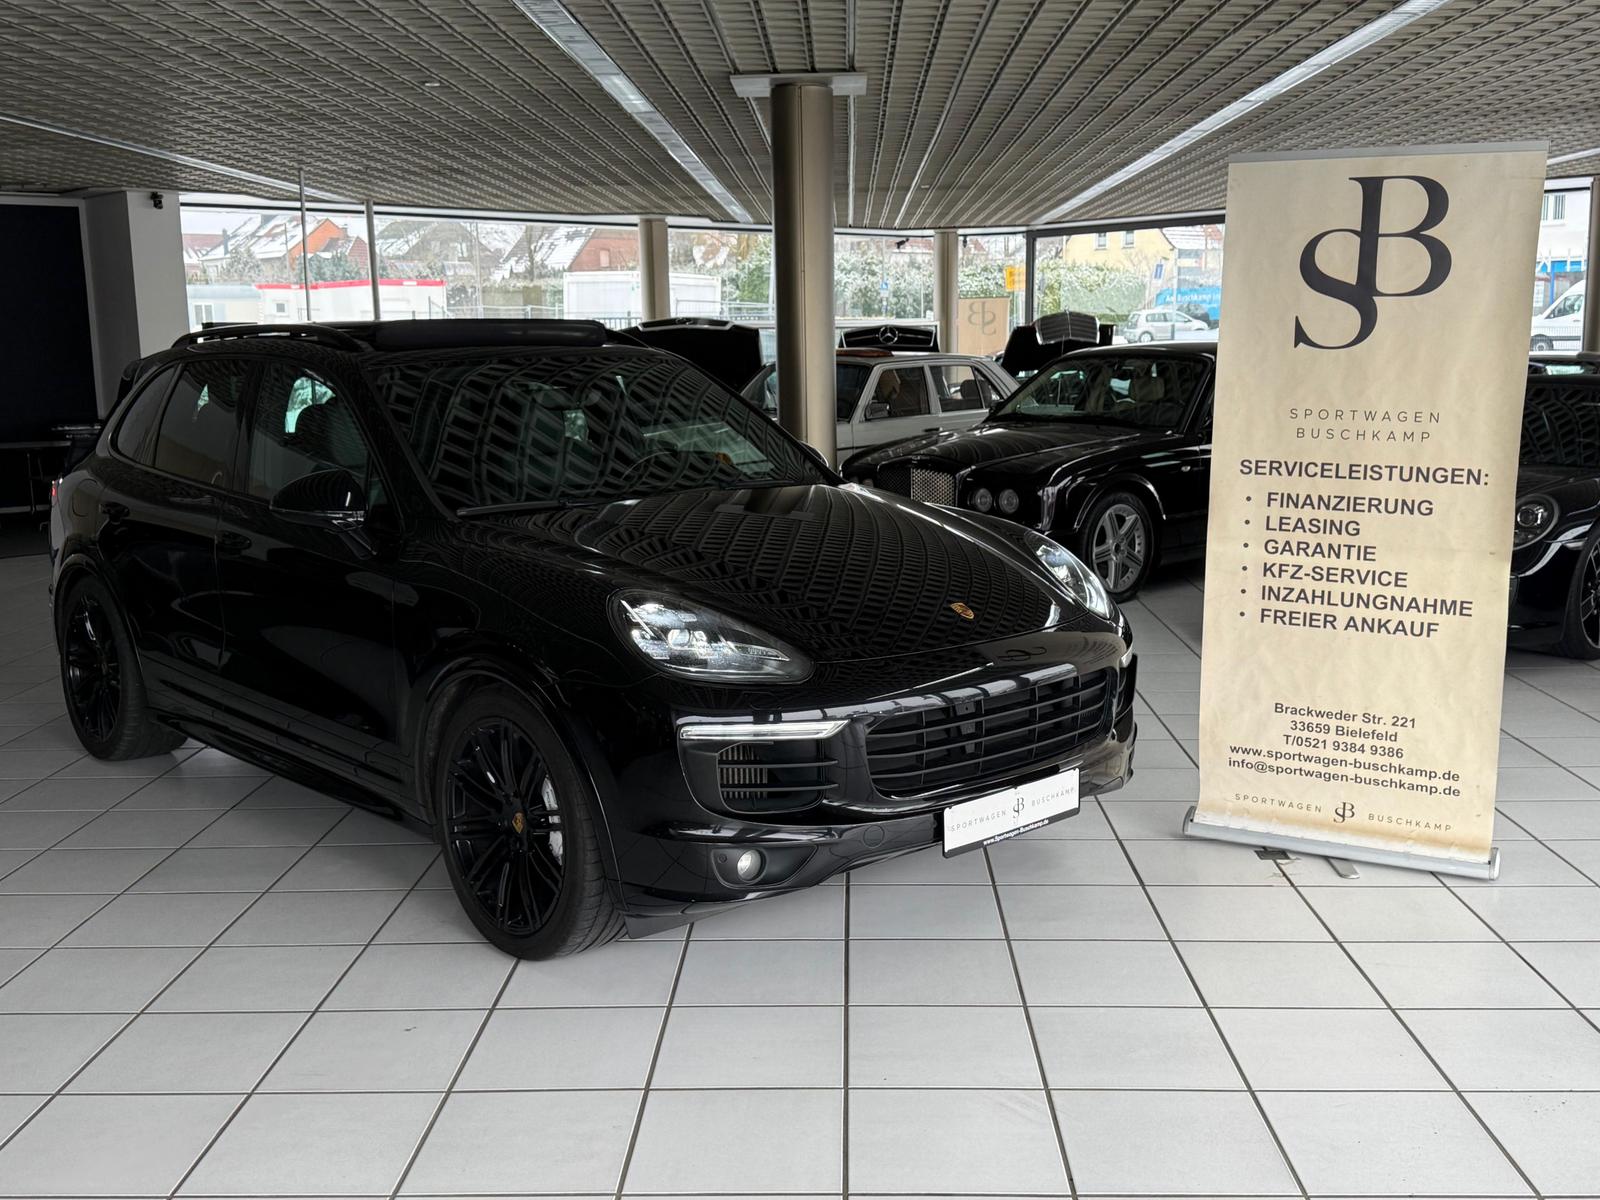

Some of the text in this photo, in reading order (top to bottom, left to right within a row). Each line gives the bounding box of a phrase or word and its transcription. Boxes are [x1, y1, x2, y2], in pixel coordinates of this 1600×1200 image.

[1289, 407, 1441, 424] SPORTWAGEN
[1296, 427, 1431, 443] BUSCHKAMP
[1239, 458, 1490, 487] SERVICELEISTUNGEN:
[1266, 491, 1434, 517] FINANZIERUNG
[1265, 514, 1361, 537] LEASING
[1263, 538, 1377, 563] GARANTIE
[1262, 561, 1409, 589] KFZ-SERVICE
[1261, 584, 1474, 618] INZAHLUNGNAHME
[1259, 607, 1440, 639] FREIER ANKAUF
[1274, 701, 1417, 729] Brackweder Str. 221
[1289, 719, 1399, 743] 33659 Bielefeld
[1282, 733, 1405, 760] T/0521 9384 9386
[1227, 756, 1461, 798] info@sportwagen-buschkamp.de
[1229, 744, 1461, 783] www.sportwagen-buschkamp.de
[951, 809, 1007, 832] SPORTWAGEN
[1031, 786, 1076, 807] BUSCHKAMP
[1234, 793, 1323, 814] SPORTWAGEN
[1367, 812, 1452, 832] BUSCHKAMP
